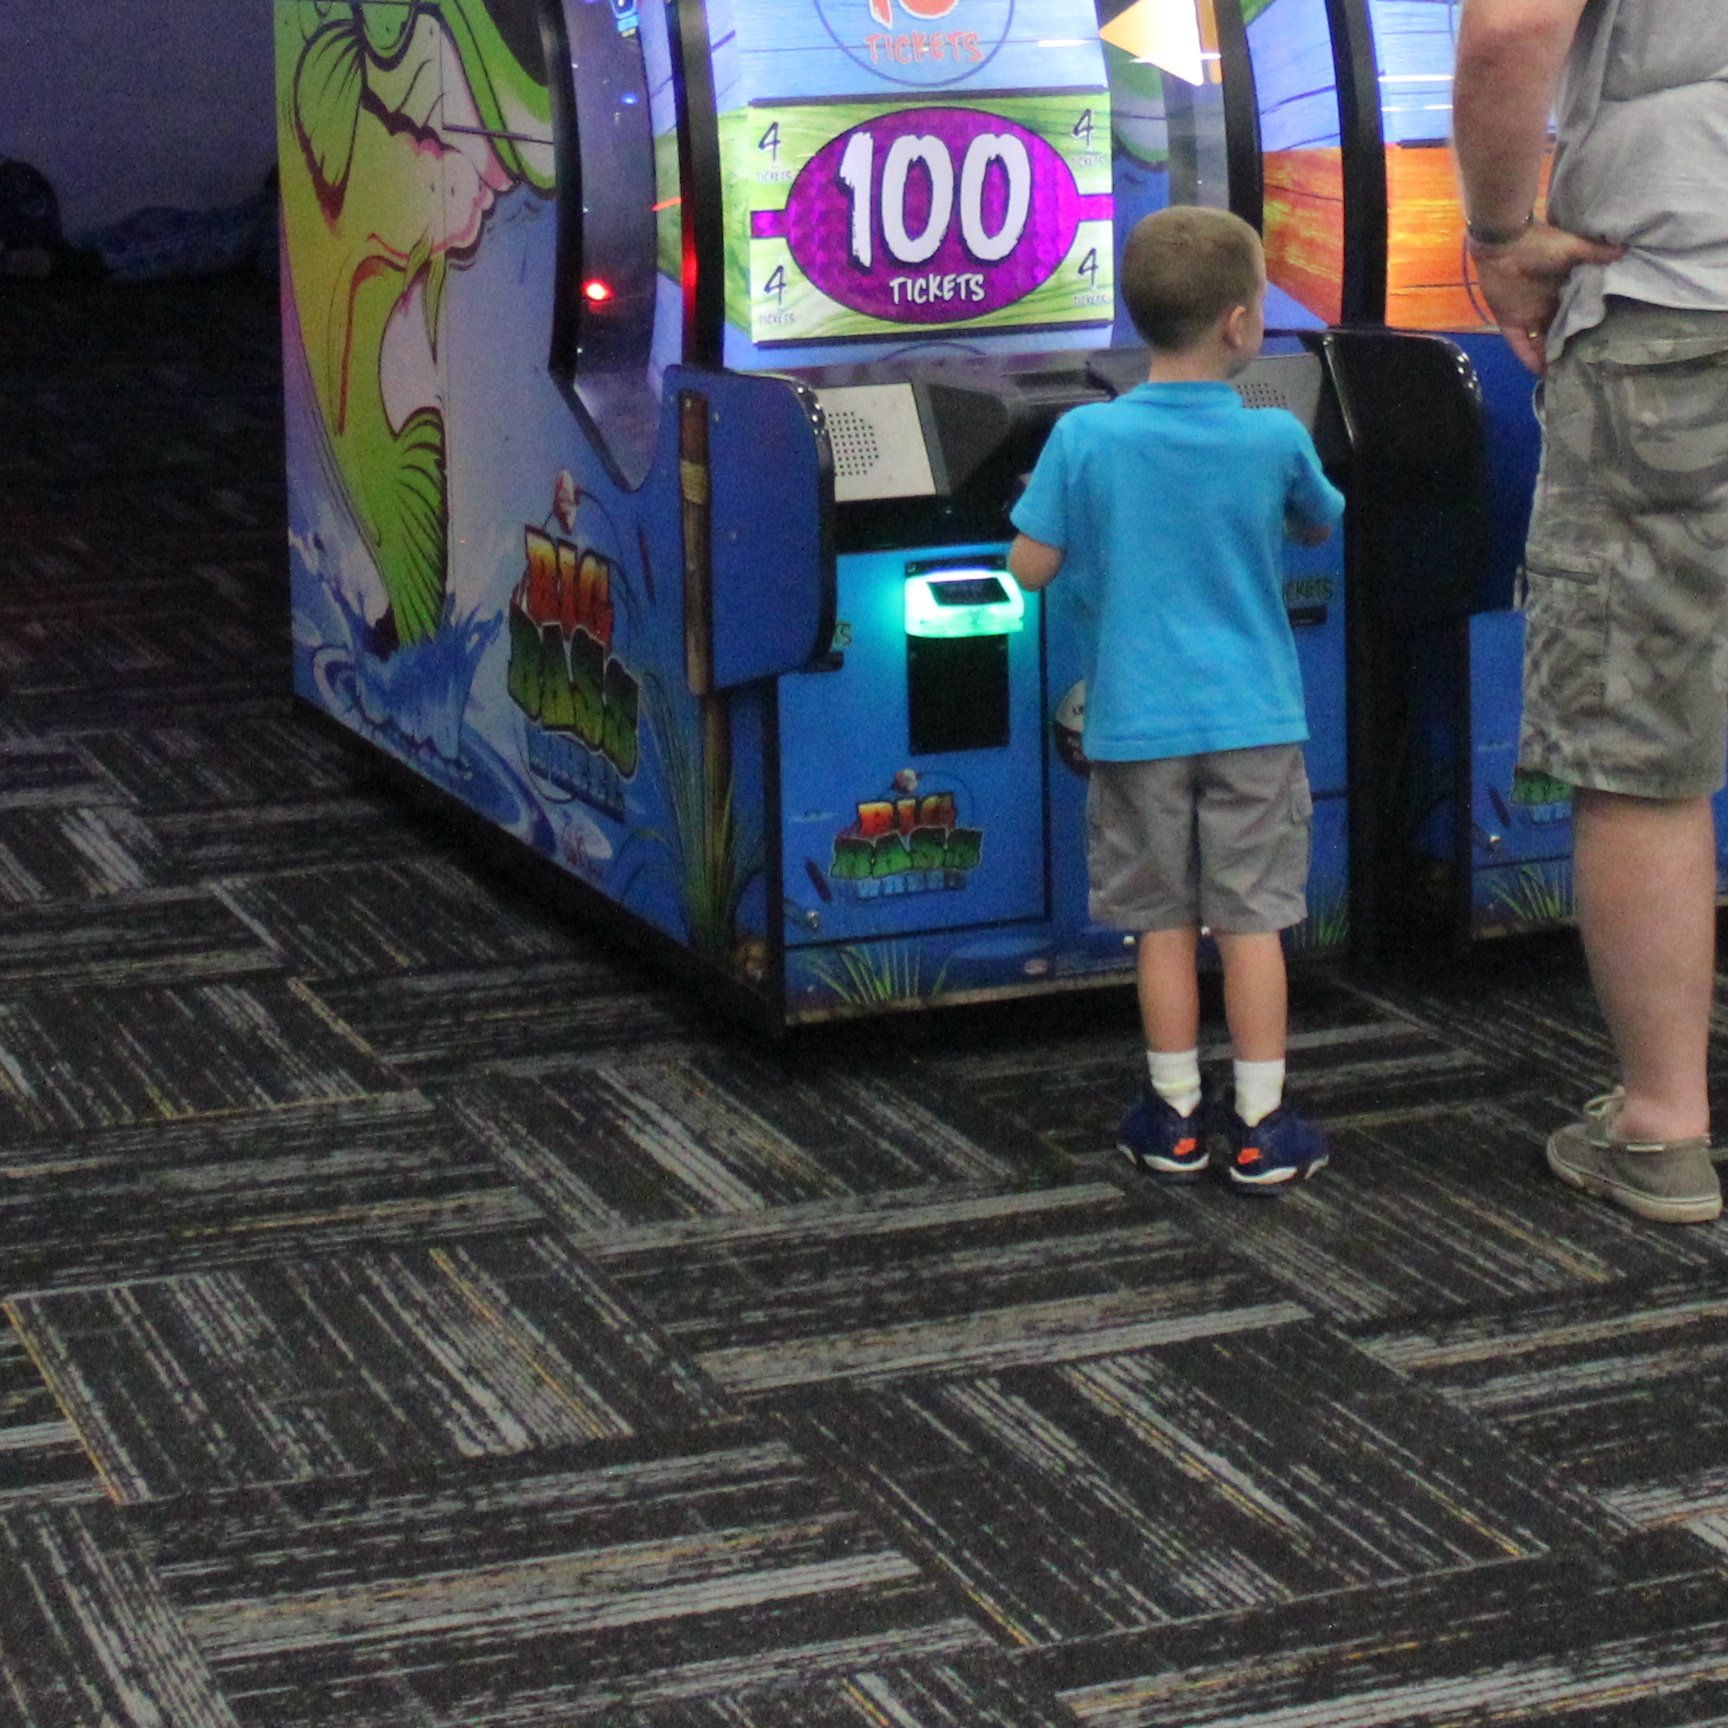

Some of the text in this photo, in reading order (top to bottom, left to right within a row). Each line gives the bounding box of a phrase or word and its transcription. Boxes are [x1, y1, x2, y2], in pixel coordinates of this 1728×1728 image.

[865, 30, 984, 65] TICKETS
[757, 121, 781, 163] 4
[1073, 108, 1094, 148] 4
[838, 130, 1032, 272] 100
[764, 265, 786, 307] 4
[1078, 247, 1100, 287] 4
[889, 272, 986, 305] TICKETS
[524, 523, 614, 654] BIG
[507, 608, 640, 780] BASS
[857, 791, 958, 840] BIG
[830, 826, 984, 879] BASS
